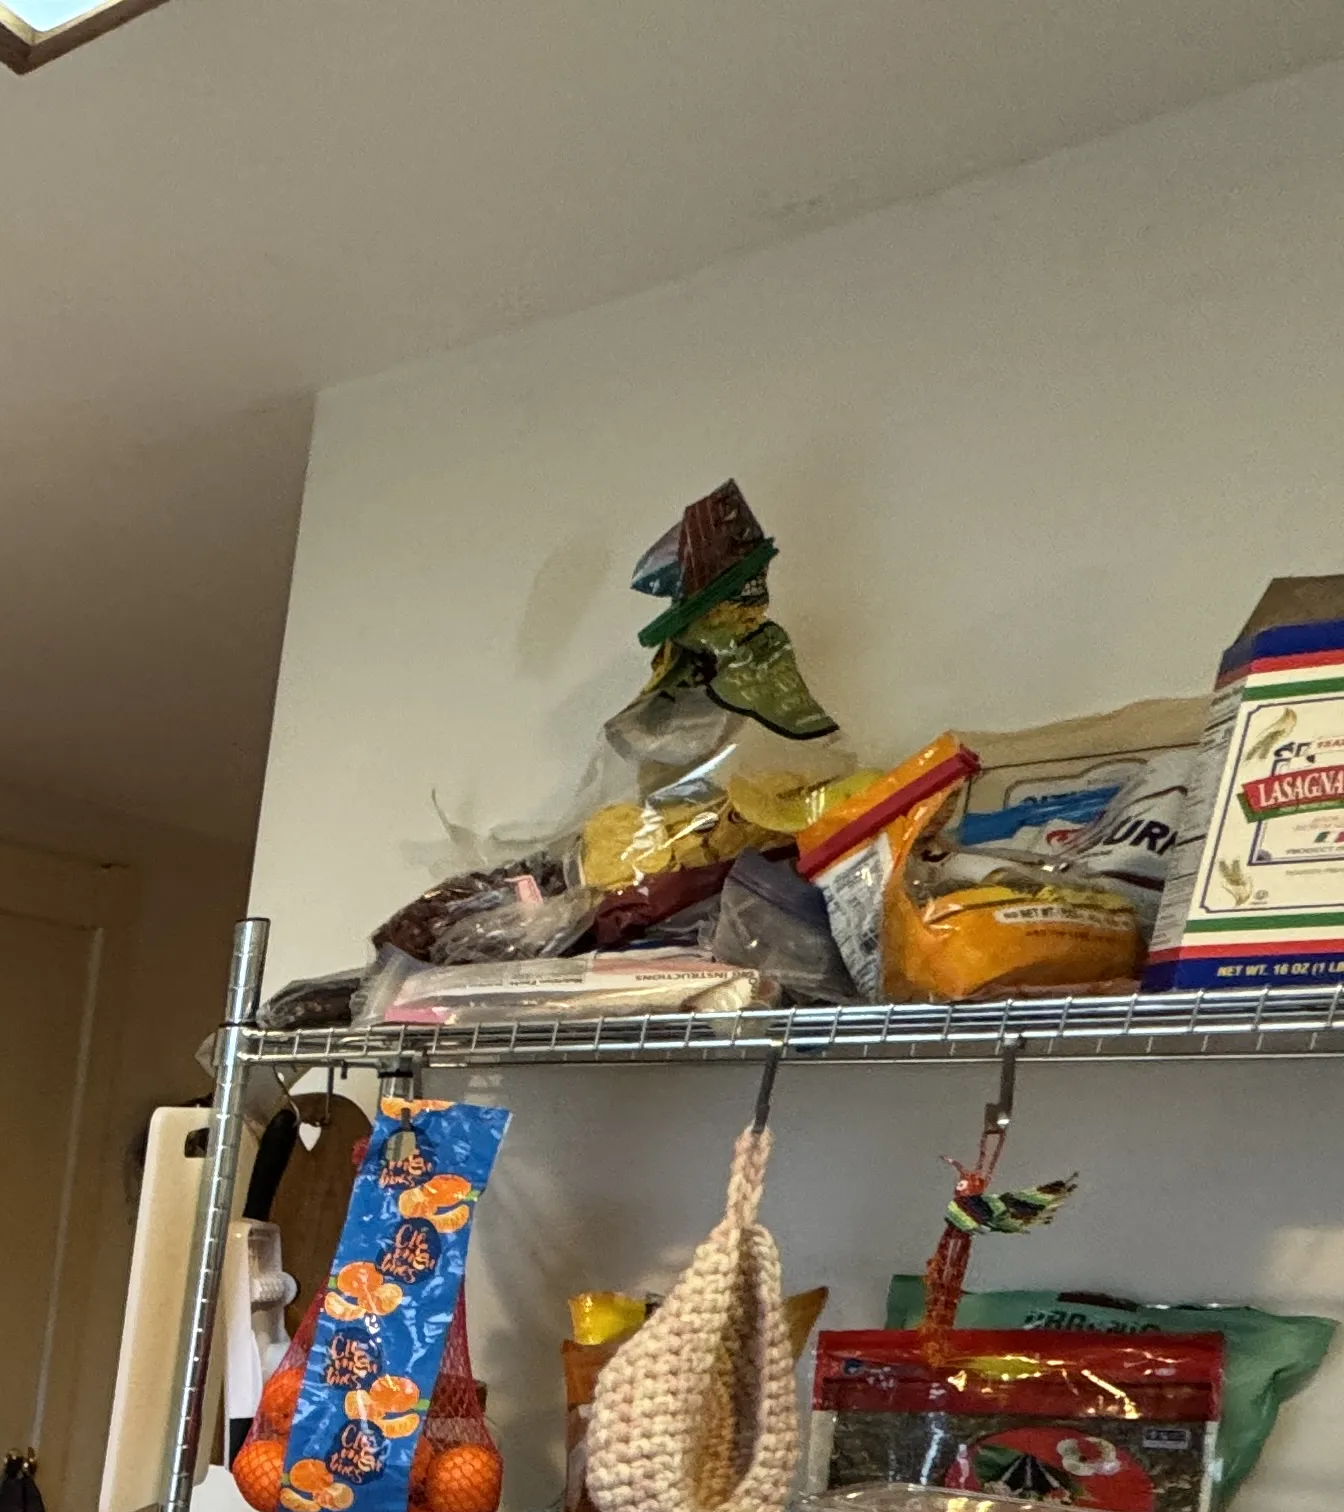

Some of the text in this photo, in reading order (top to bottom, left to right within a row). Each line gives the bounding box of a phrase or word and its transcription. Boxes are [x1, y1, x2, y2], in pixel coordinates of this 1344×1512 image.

[1217, 965, 1243, 977] NET
[1273, 964, 1289, 975] 16
[1291, 963, 1310, 975] OZ
